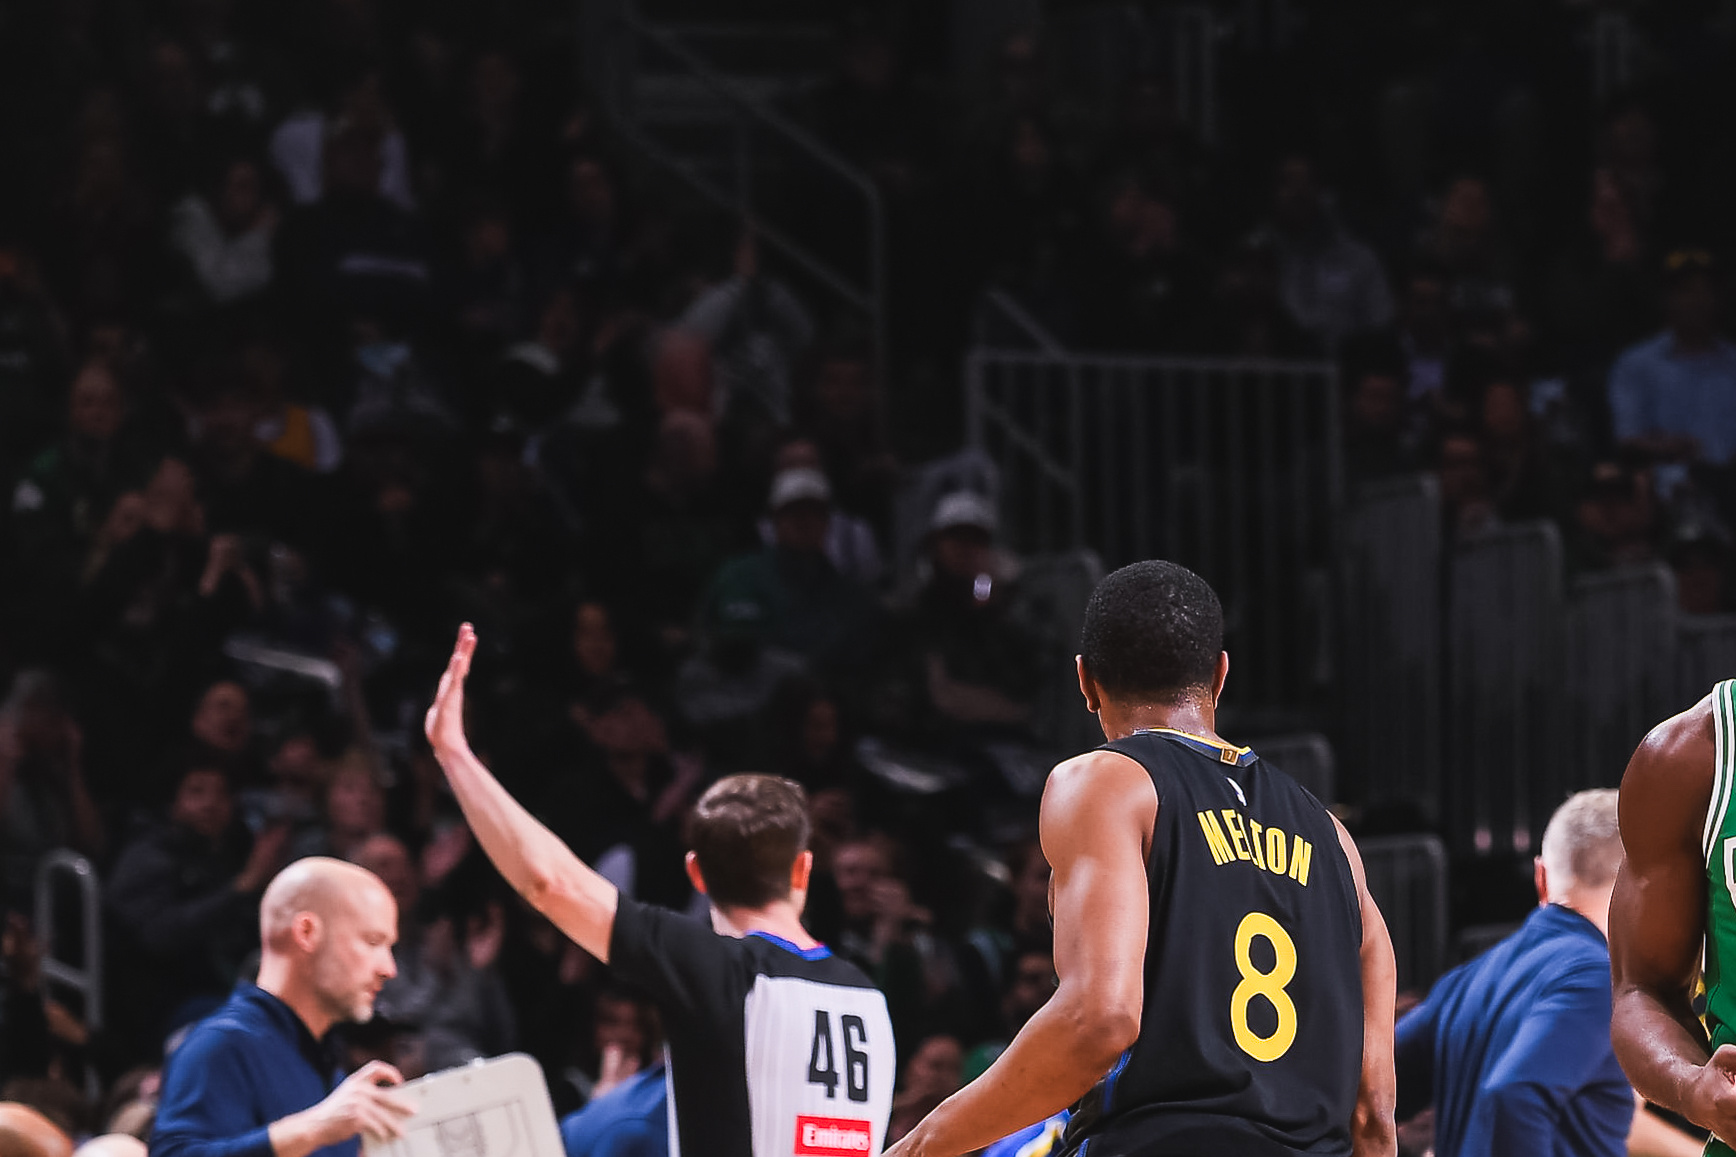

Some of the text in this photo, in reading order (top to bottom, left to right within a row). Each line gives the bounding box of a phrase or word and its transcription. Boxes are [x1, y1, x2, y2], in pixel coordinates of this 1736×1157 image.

[1197, 808, 1312, 887] MELTON
[1230, 911, 1298, 1062] 8
[808, 1009, 868, 1102] 46
